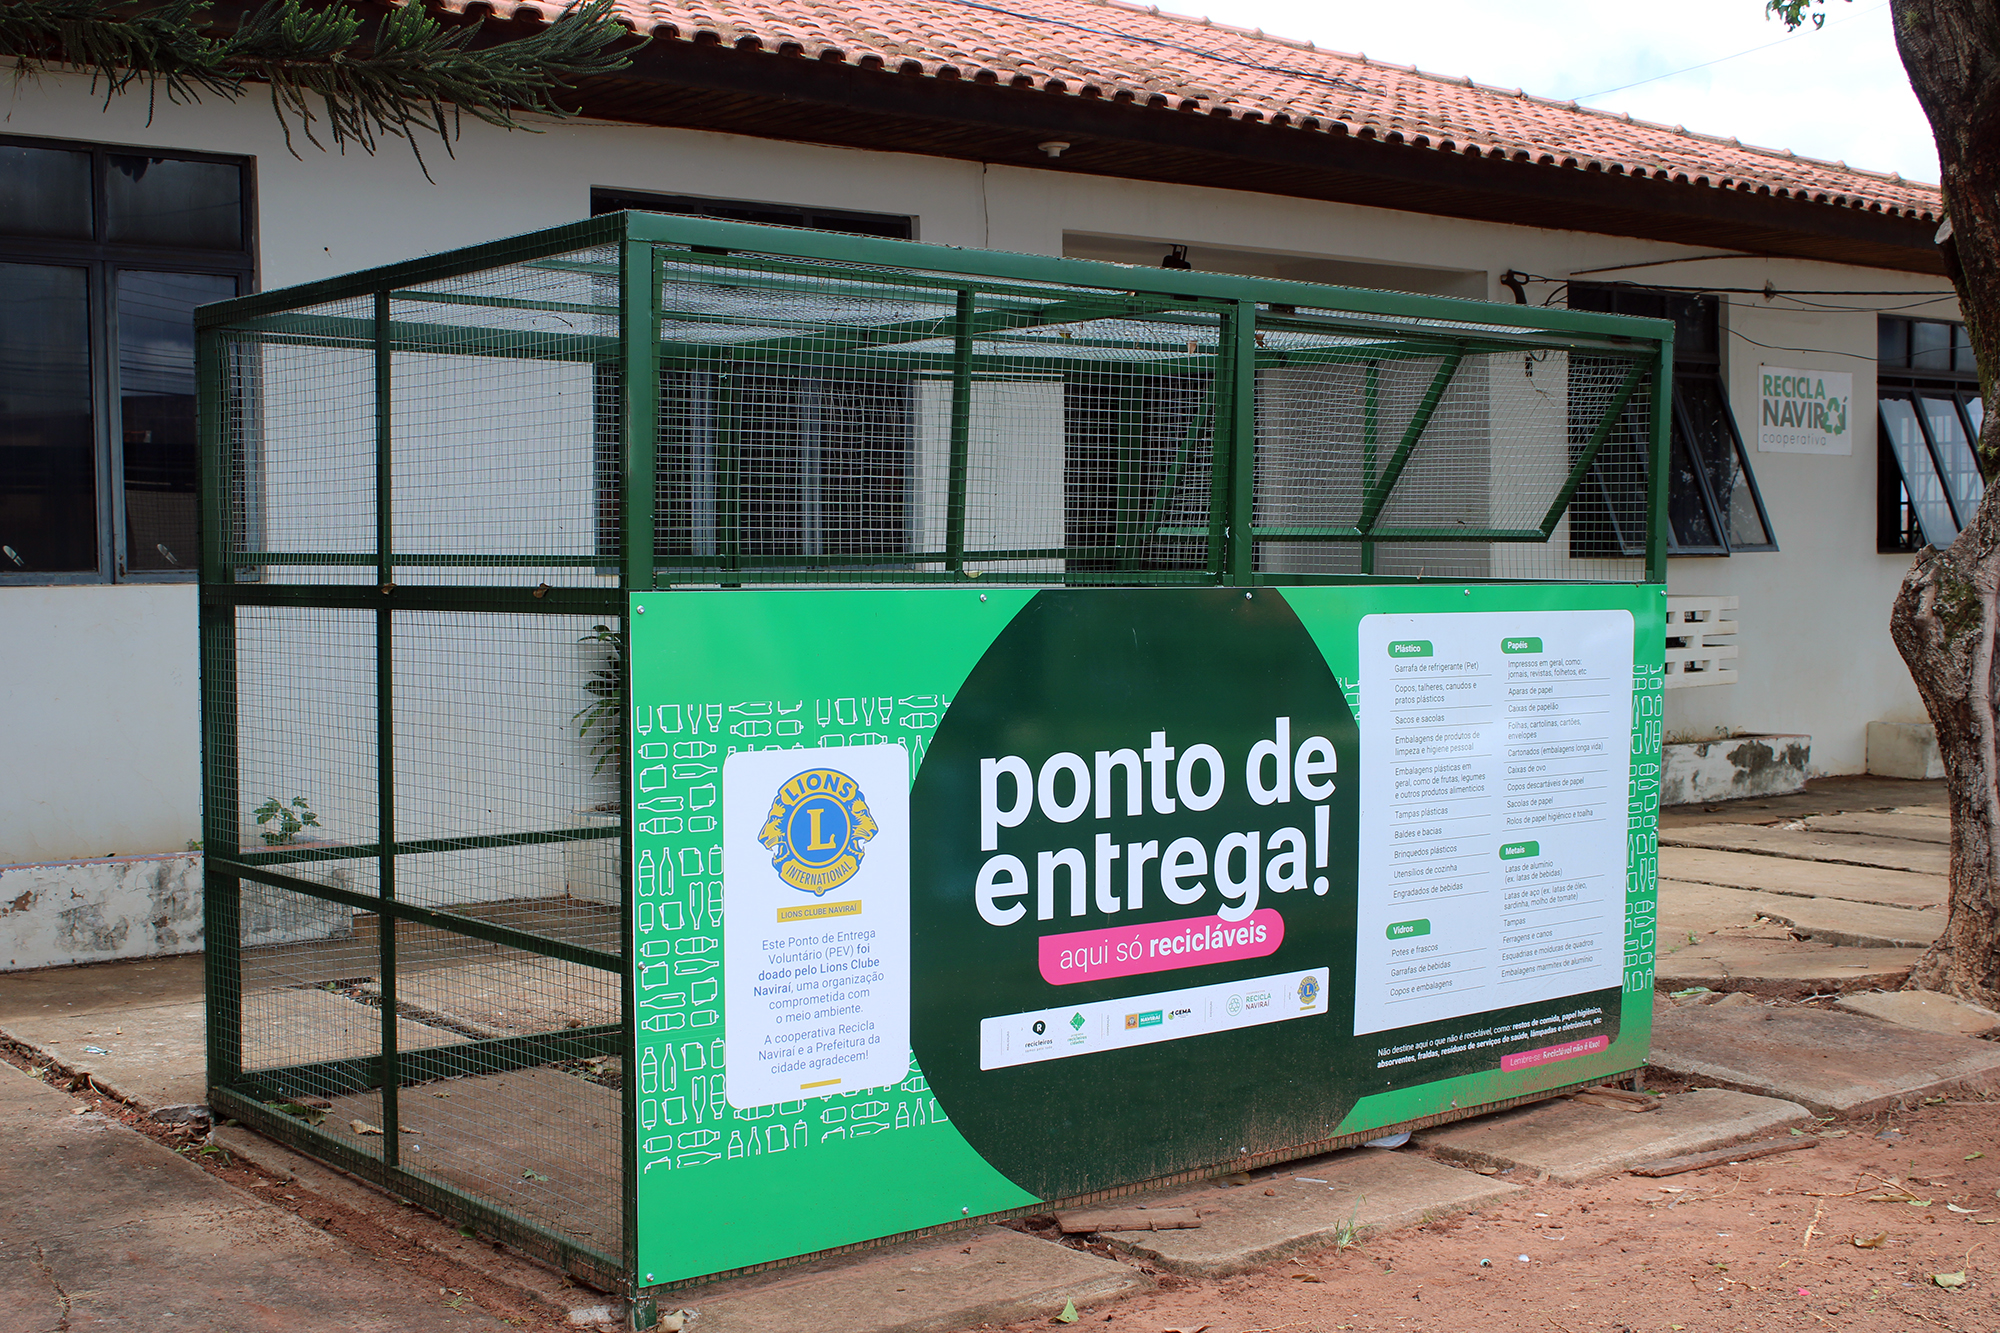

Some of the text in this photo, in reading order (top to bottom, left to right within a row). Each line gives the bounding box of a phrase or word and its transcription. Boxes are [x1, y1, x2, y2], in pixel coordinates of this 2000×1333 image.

[1763, 374, 1826, 400] RECICLA
[1762, 433, 1827, 448] cooperativa
[1395, 644, 1420, 652] Plástico
[1394, 664, 1417, 672] Garrafa
[1428, 662, 1462, 672] refrigerante
[1508, 660, 1537, 669] Impressos
[1445, 681, 1471, 690] canudos
[1508, 685, 1552, 696] Aparas papel
[1395, 694, 1444, 705] pratos plásticos
[1508, 701, 1558, 713] Caixas papelão
[1395, 714, 1444, 725] Sacos sacolas
[1395, 732, 1470, 744] Embalagens produtos
[1508, 732, 1536, 741] envelopes
[1426, 742, 1473, 755] higiene pessoal
[1576, 744, 1589, 753] longa
[1395, 763, 1460, 776] Embalagens plásticas
[1507, 765, 1526, 774] Caixas
[980, 716, 1338, 851] ponto de
[1461, 774, 1485, 783] legumes
[1507, 776, 1584, 792] Copos descartáveis papel
[785, 773, 853, 803] LIONS
[1421, 788, 1448, 798] produtos
[1507, 796, 1553, 808] Sacolas papel
[1395, 806, 1448, 819] Tampas plásticas
[1506, 808, 1592, 824] Rolos papel toalha
[806, 808, 837, 851] L
[1394, 827, 1442, 839] Baldes bacias
[1394, 845, 1457, 859] Brinquedos plásticos
[1505, 846, 1524, 855] Metais
[975, 805, 1331, 927] entrega!
[1394, 863, 1457, 878] Utensílios cozinha
[1505, 860, 1553, 873] Latas alumínio
[785, 861, 853, 886] INTERNATIONAL
[1393, 882, 1462, 899] Engradados bebidas
[1504, 891, 1520, 900] Latas
[1529, 889, 1539, 898] aço
[1552, 885, 1565, 894] latas
[1530, 897, 1548, 906] molho
[781, 903, 857, 919] LIONS CLUBE NAVIRAÍ
[1503, 918, 1525, 927] Tampas
[1393, 926, 1413, 934] Vidros
[762, 931, 875, 950] Este Ponto de Entrega
[1503, 931, 1552, 943] Ferragens canos
[1059, 920, 1267, 973] aqui só recicláveis
[1391, 944, 1438, 957] Potes frascos
[1502, 939, 1593, 961] Esquadrias molduras quadros
[768, 943, 869, 964] Voluntário (PEV) foi
[758, 957, 879, 981] doado pelo Lions Clube
[1390, 961, 1450, 976] Garrafas bebidas
[1501, 954, 1592, 977] Embalagens marmitex alumínio
[754, 971, 884, 996] Naviraí, uma organização
[1390, 980, 1452, 997] Copos embalagens
[769, 989, 869, 1010] comprometida com
[1246, 992, 1272, 1002] RECICLA
[1246, 1000, 1270, 1010] NAVIRAÍ
[776, 1004, 863, 1024] o meio ambiente.
[764, 1020, 874, 1045] A cooperativa Recicla
[759, 1034, 880, 1061] Naviraí e a Prefeitura da
[1024, 1039, 1053, 1048] recicleiros
[771, 1049, 868, 1074] cidade agradecem!
